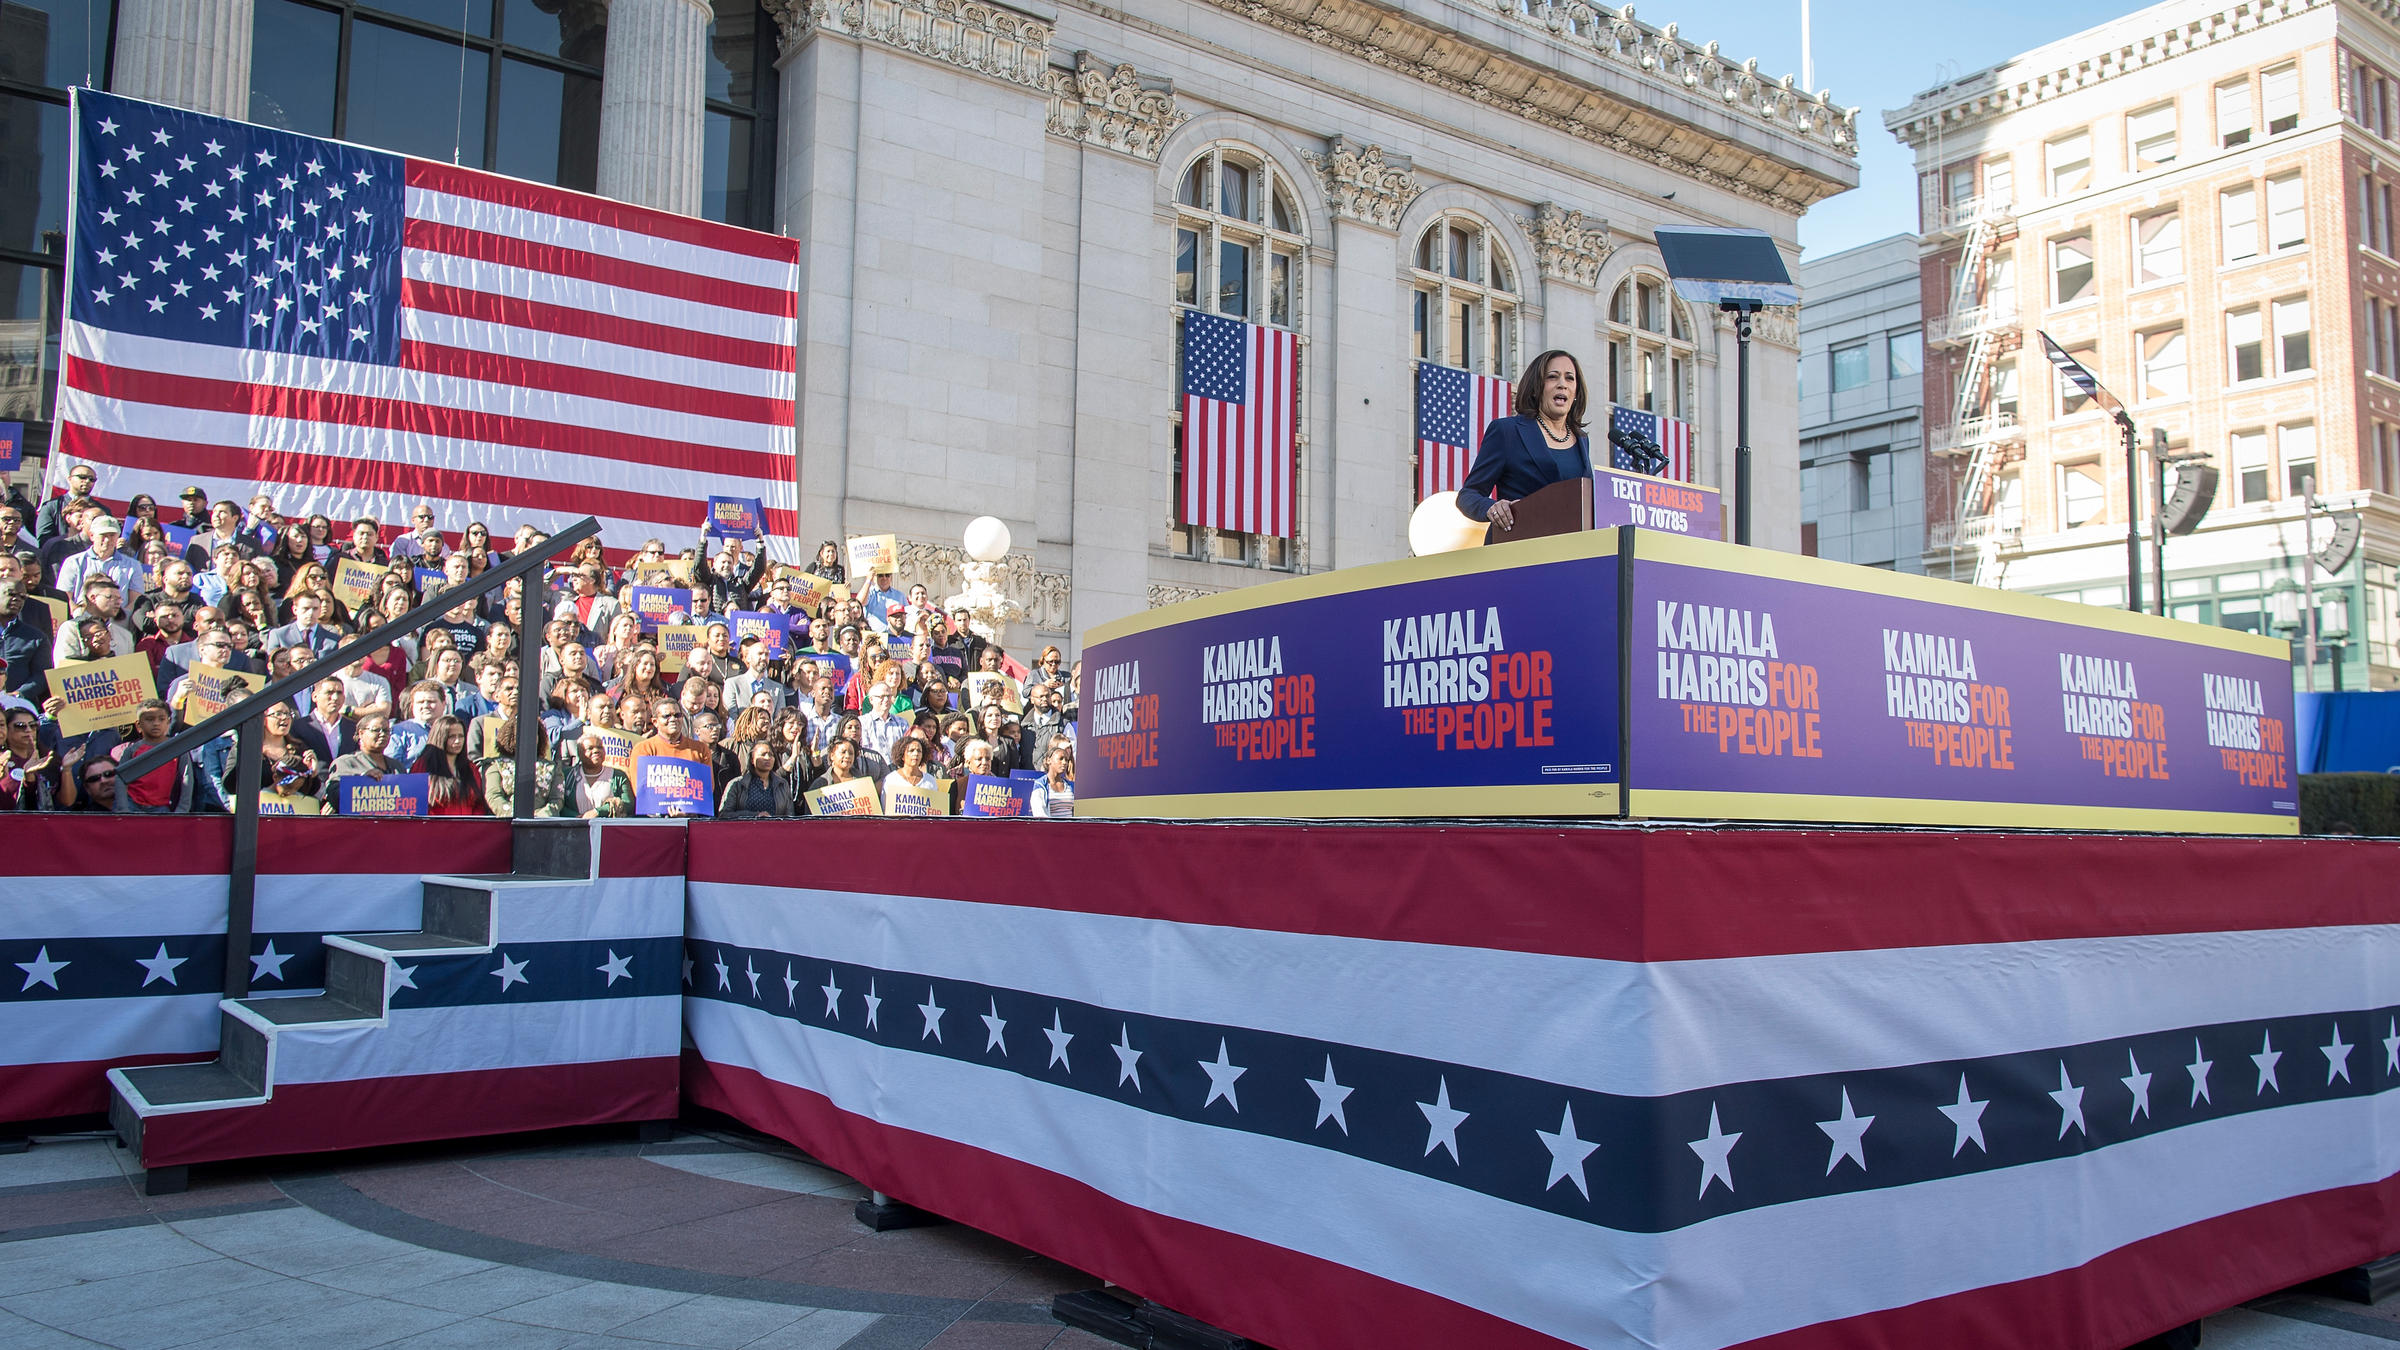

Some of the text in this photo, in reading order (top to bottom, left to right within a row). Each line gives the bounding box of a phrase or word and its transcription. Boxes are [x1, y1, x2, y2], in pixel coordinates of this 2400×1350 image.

[0, 440, 13, 449] OR
[1611, 477, 1704, 512] TEXT FEARLESS
[715, 502, 743, 512] KAMALA
[714, 511, 752, 520] HARRIS FOR
[1629, 503, 1688, 532] TO 70785
[728, 520, 752, 528] PEOPLE
[640, 593, 673, 605] KAMALA
[794, 593, 818, 608] PEOPLE
[808, 589, 822, 600] FOR
[639, 603, 669, 613] HARRIS
[736, 618, 770, 630] KAMALA
[1657, 600, 1778, 659] KAMALA
[455, 634, 477, 644] RRIS
[666, 633, 696, 642] KAMALA
[766, 629, 781, 638] FOR
[1384, 606, 1504, 662] KAMALA
[666, 642, 694, 651] HARRIS
[1882, 628, 1977, 681] KAMALA
[1203, 636, 1283, 684] KAMALA
[62, 669, 118, 690] KAMALA
[198, 672, 222, 689] KAMA
[1094, 660, 1140, 702] KAMALA
[1384, 650, 1552, 708] HARRIS FOR
[1658, 651, 1819, 710] HARRIS FOR
[2059, 652, 2138, 699] KAMALA
[66, 678, 142, 704] HARRIS FOR
[1202, 674, 1316, 724] HARRIS FOR
[2202, 672, 2264, 715] KAMALA
[79, 691, 143, 712] THE PEOPLE
[1885, 674, 2010, 727] HARRIS FOR
[1092, 694, 1159, 737] HARRIS FOR
[2062, 694, 2166, 741] HARRIS FOR
[1402, 700, 1554, 751] THE PEOPLE
[1680, 704, 1822, 758] THE PEOPLE
[2206, 710, 2284, 752] HARRIS FOR
[602, 736, 633, 750] AMALA
[1215, 717, 1316, 761] THE PEOPLE
[1905, 721, 2014, 770] THE PEOPLE
[607, 746, 630, 758] RRIS
[1098, 731, 1159, 770] THE PEOPLE
[2080, 736, 2170, 780] THE PEOPLE
[612, 756, 630, 768] PEO
[2221, 749, 2288, 789] THE PEOPLE
[648, 764, 690, 778] KAMALA
[647, 776, 704, 790] HARRIS FOR
[976, 783, 1012, 798] KAMALA
[352, 785, 400, 798] KAMALA
[666, 787, 704, 800] PEOPLE
[817, 790, 856, 806] KAMALA
[258, 803, 295, 814] MALA
[352, 797, 416, 812] HARRIS FOR
[820, 796, 871, 815] HARRIS FOR
[896, 794, 930, 807] KAMALA
[974, 793, 1023, 808] HARRIS FOR
[895, 804, 926, 816] HARRIS
[989, 807, 1020, 816] PEOPLE
